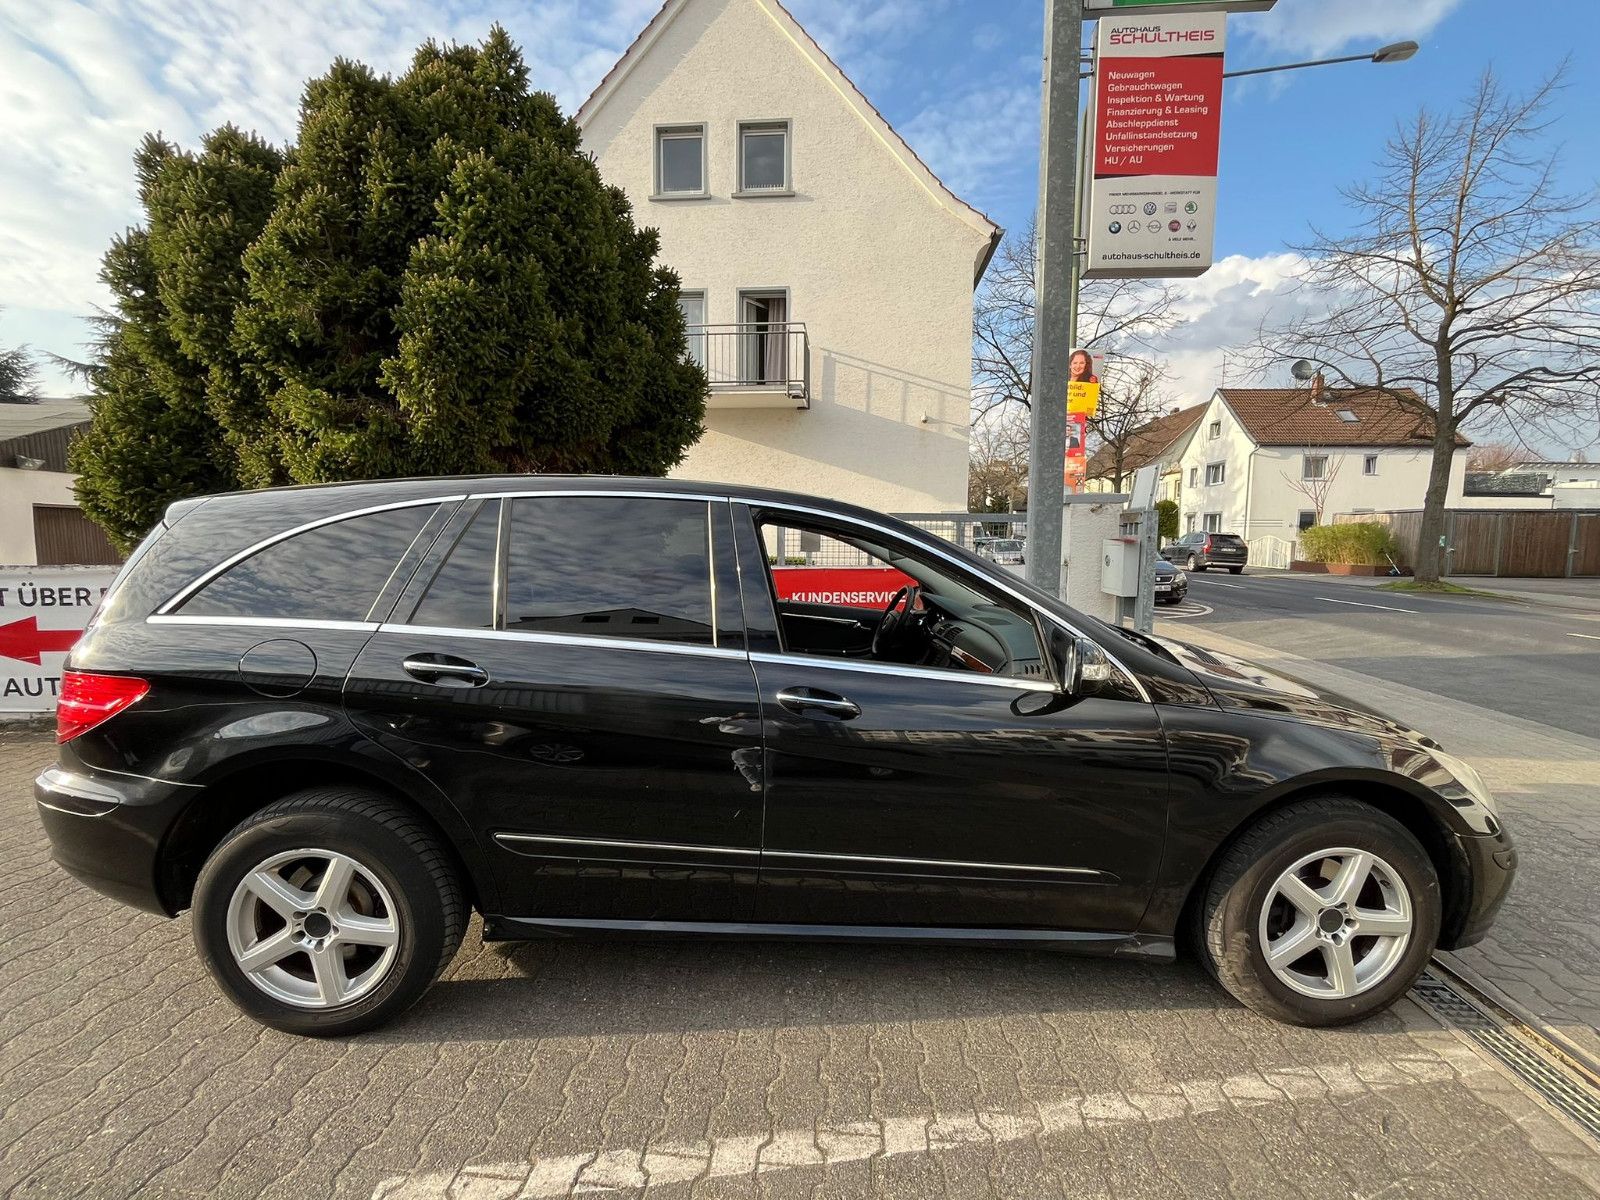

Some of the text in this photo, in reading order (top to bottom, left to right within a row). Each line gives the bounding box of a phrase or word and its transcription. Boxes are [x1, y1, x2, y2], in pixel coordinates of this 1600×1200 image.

[1110, 26, 1161, 34] AUTOHAUS
[1109, 30, 1215, 45] SCHULTHEIS
[1108, 71, 1155, 81] Neuwagen
[1108, 82, 1183, 92] Gebrauchtwagen
[1107, 93, 1205, 105] Inspektion & Wartung
[1106, 105, 1208, 117] Finanzierung & Leasing
[1106, 119, 1179, 129] Abschleppdienst
[1105, 131, 1198, 141] Unfallinstandsetzung
[1105, 144, 1174, 153] Versicherungen
[1104, 156, 1119, 165] HU
[1129, 156, 1143, 164] AU
[1102, 251, 1201, 260] autohaus-schultheis.de
[18, 582, 92, 607] ÜBER
